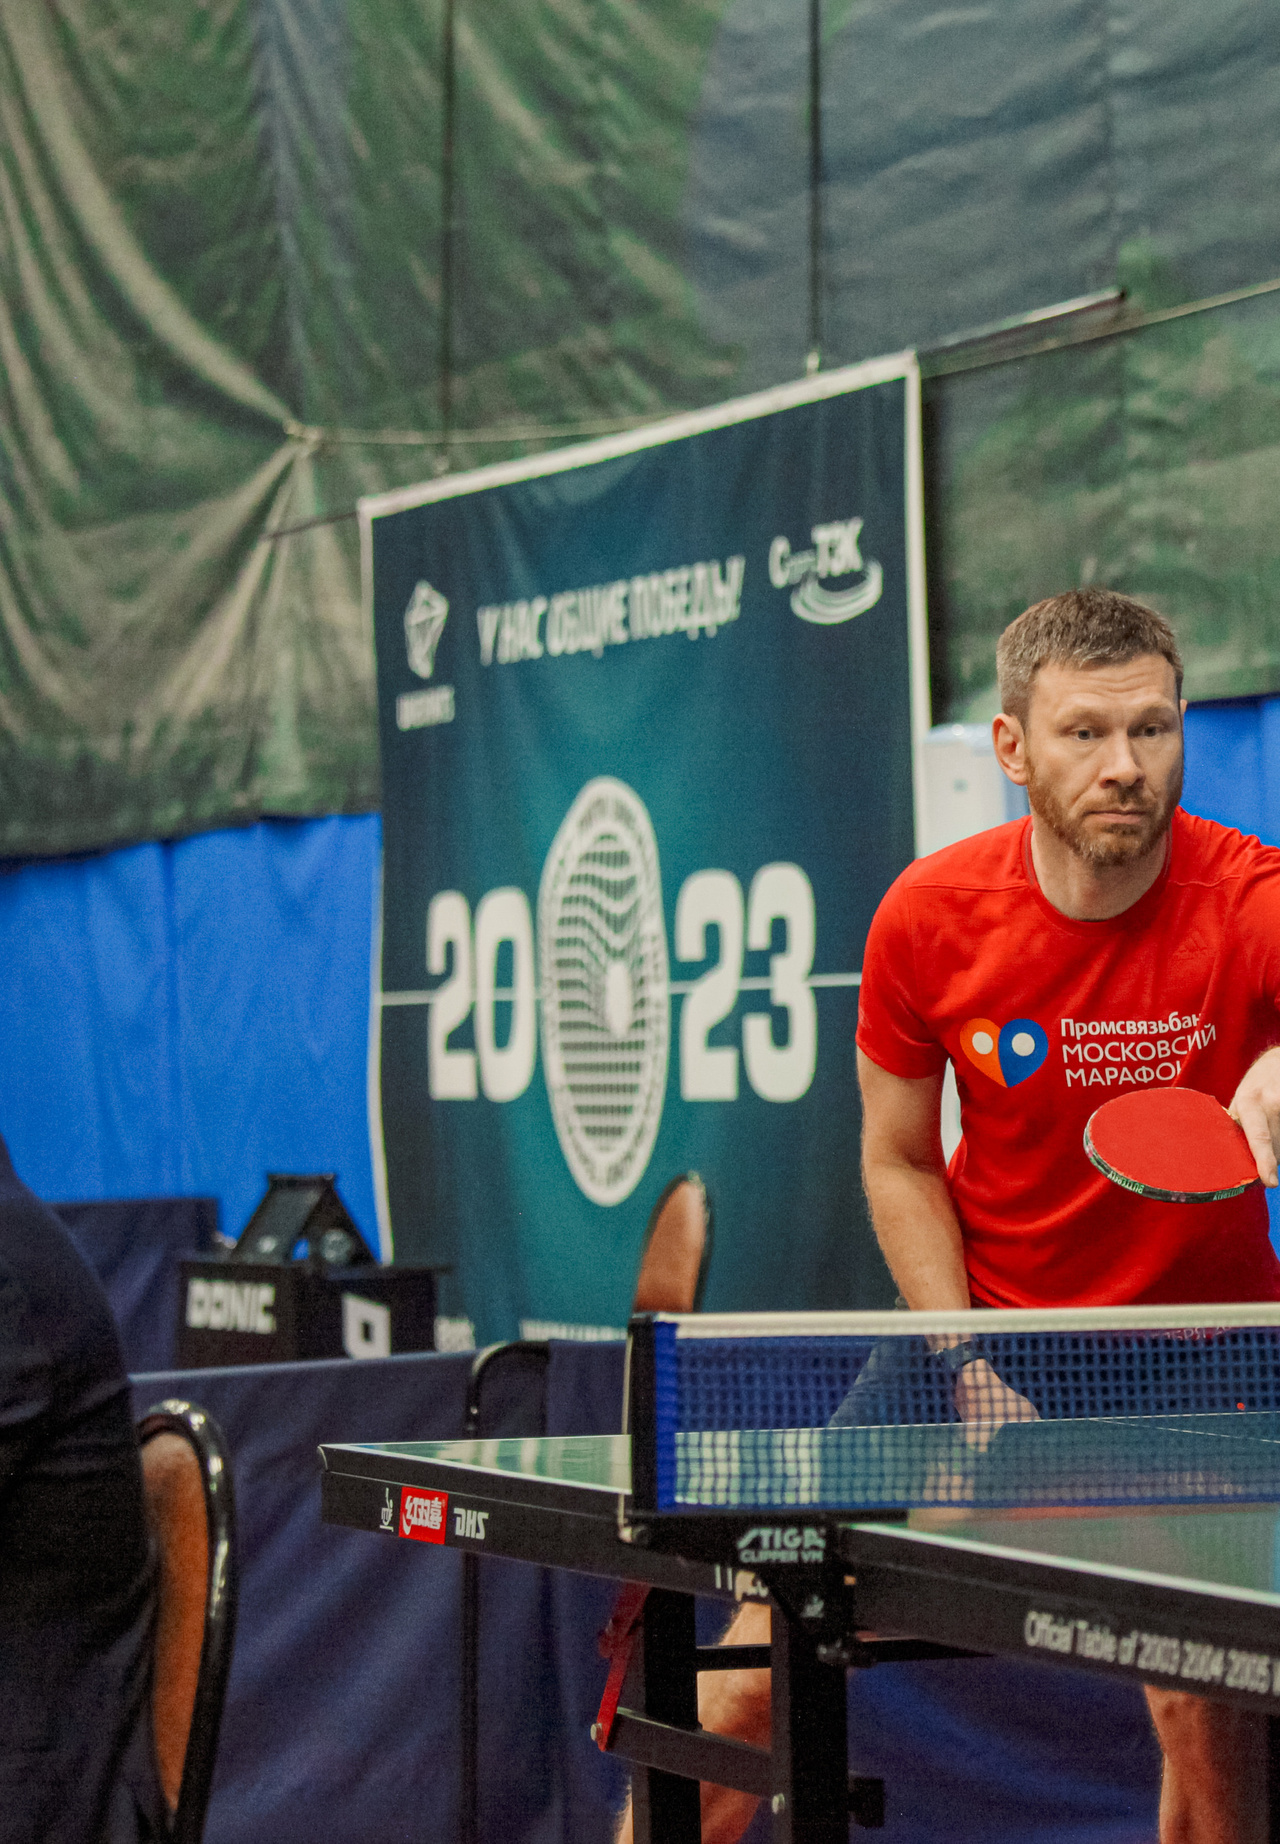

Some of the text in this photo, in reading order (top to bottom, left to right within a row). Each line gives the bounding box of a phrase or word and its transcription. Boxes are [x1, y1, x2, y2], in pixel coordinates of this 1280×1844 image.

[1060, 1011, 1202, 1041] Промсвязьбан
[737, 1527, 826, 1550] STIGA
[740, 1549, 799, 1563] CLIPPER
[1024, 1610, 1075, 1655] Official
[1075, 1619, 1117, 1663] Table
[1118, 1629, 1139, 1666] of
